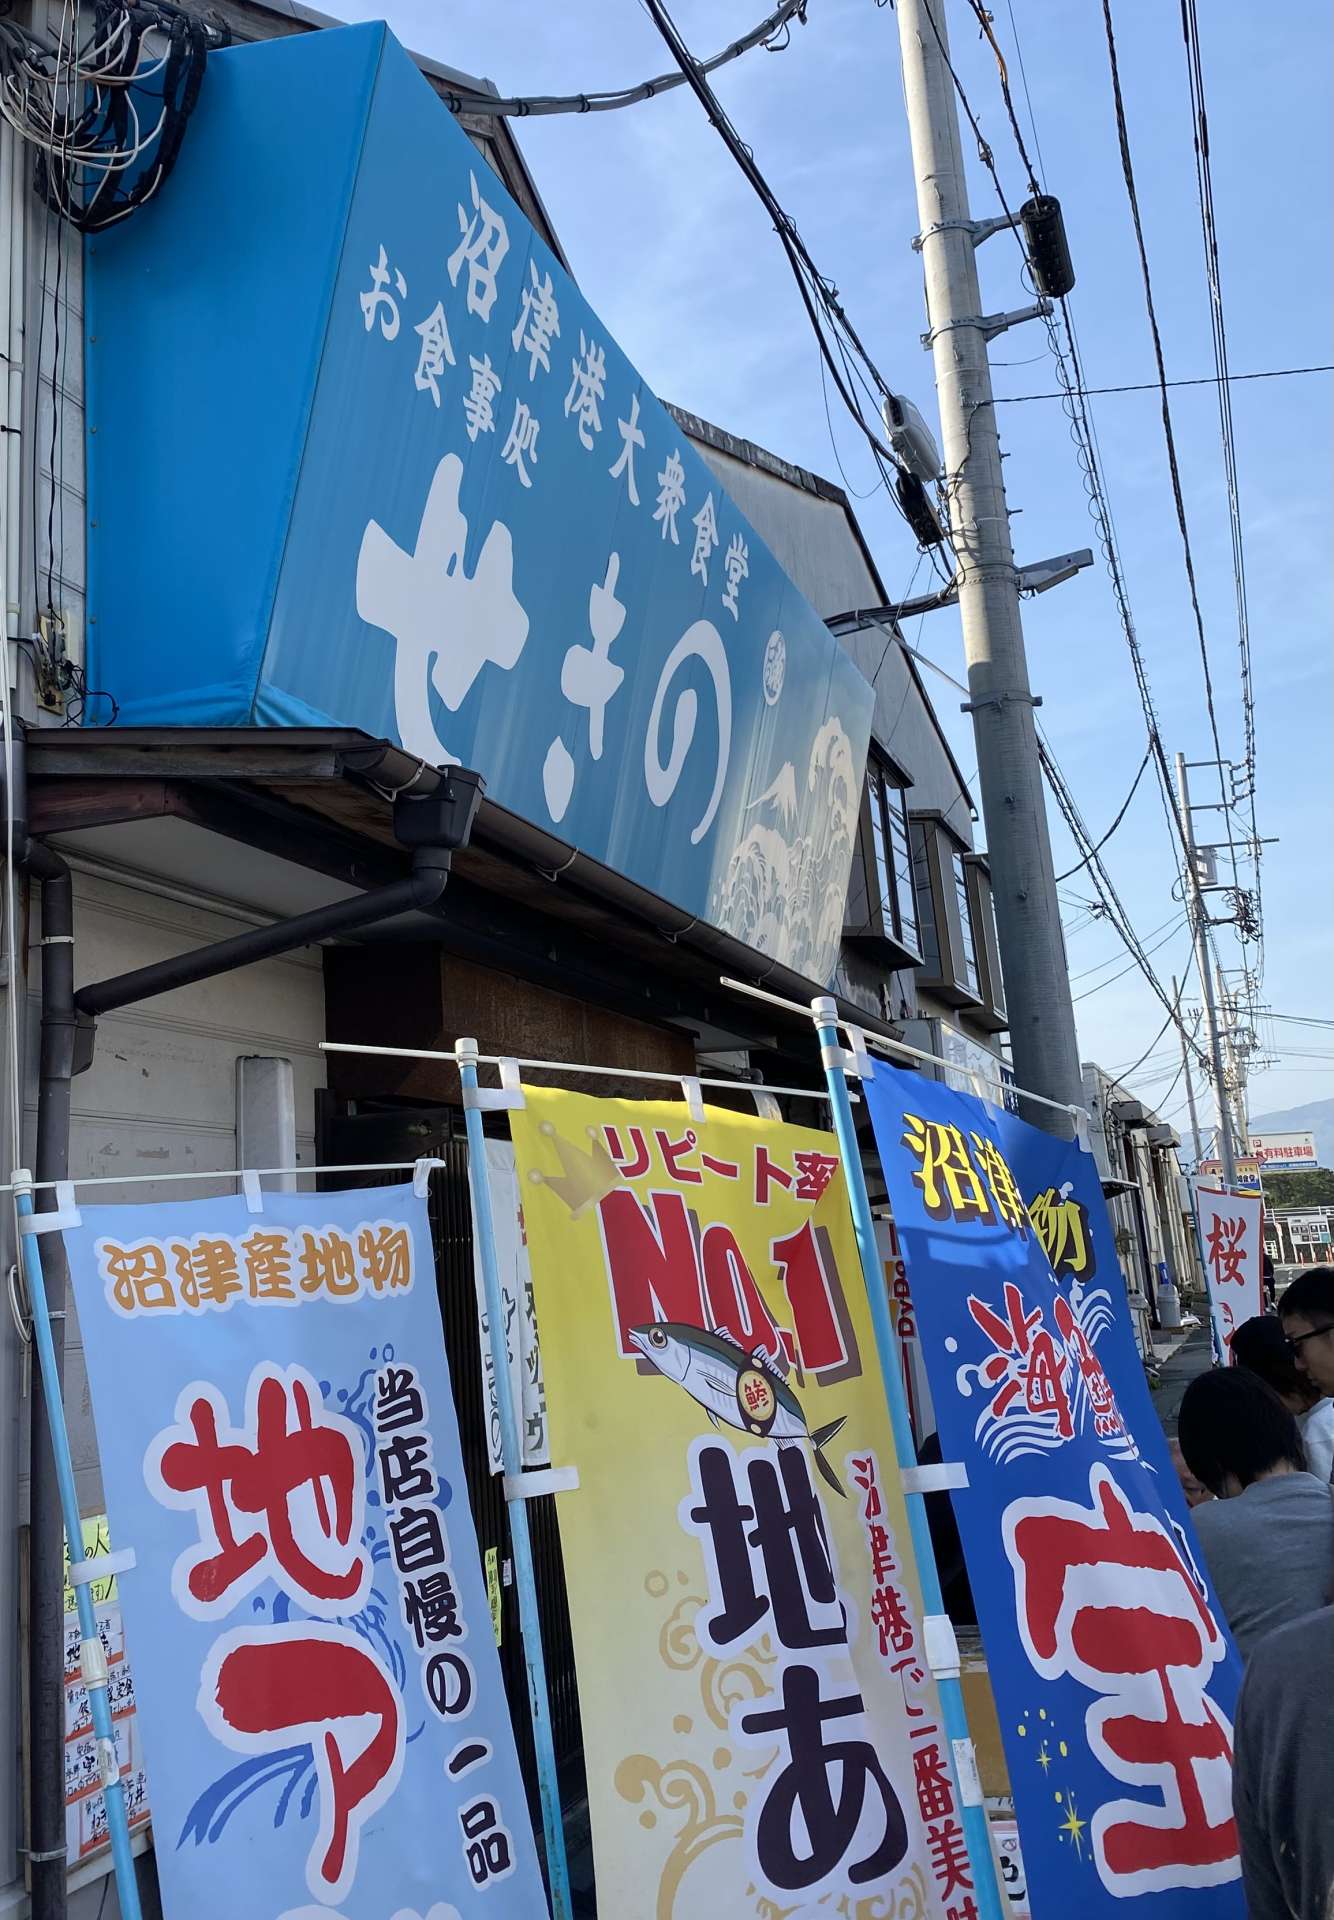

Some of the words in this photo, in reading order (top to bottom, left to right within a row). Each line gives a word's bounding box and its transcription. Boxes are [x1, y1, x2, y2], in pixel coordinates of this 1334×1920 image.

[360, 244, 540, 488] お食事処
[447, 169, 749, 621] 沼津港大衆食堂
[356, 452, 732, 845] せきの
[102, 1226, 411, 1311] 沼津産地物
[603, 1126, 840, 1204] リピート率
[376, 1366, 511, 1885] 当店自慢の一品
[690, 1446, 908, 1891] 地あ
